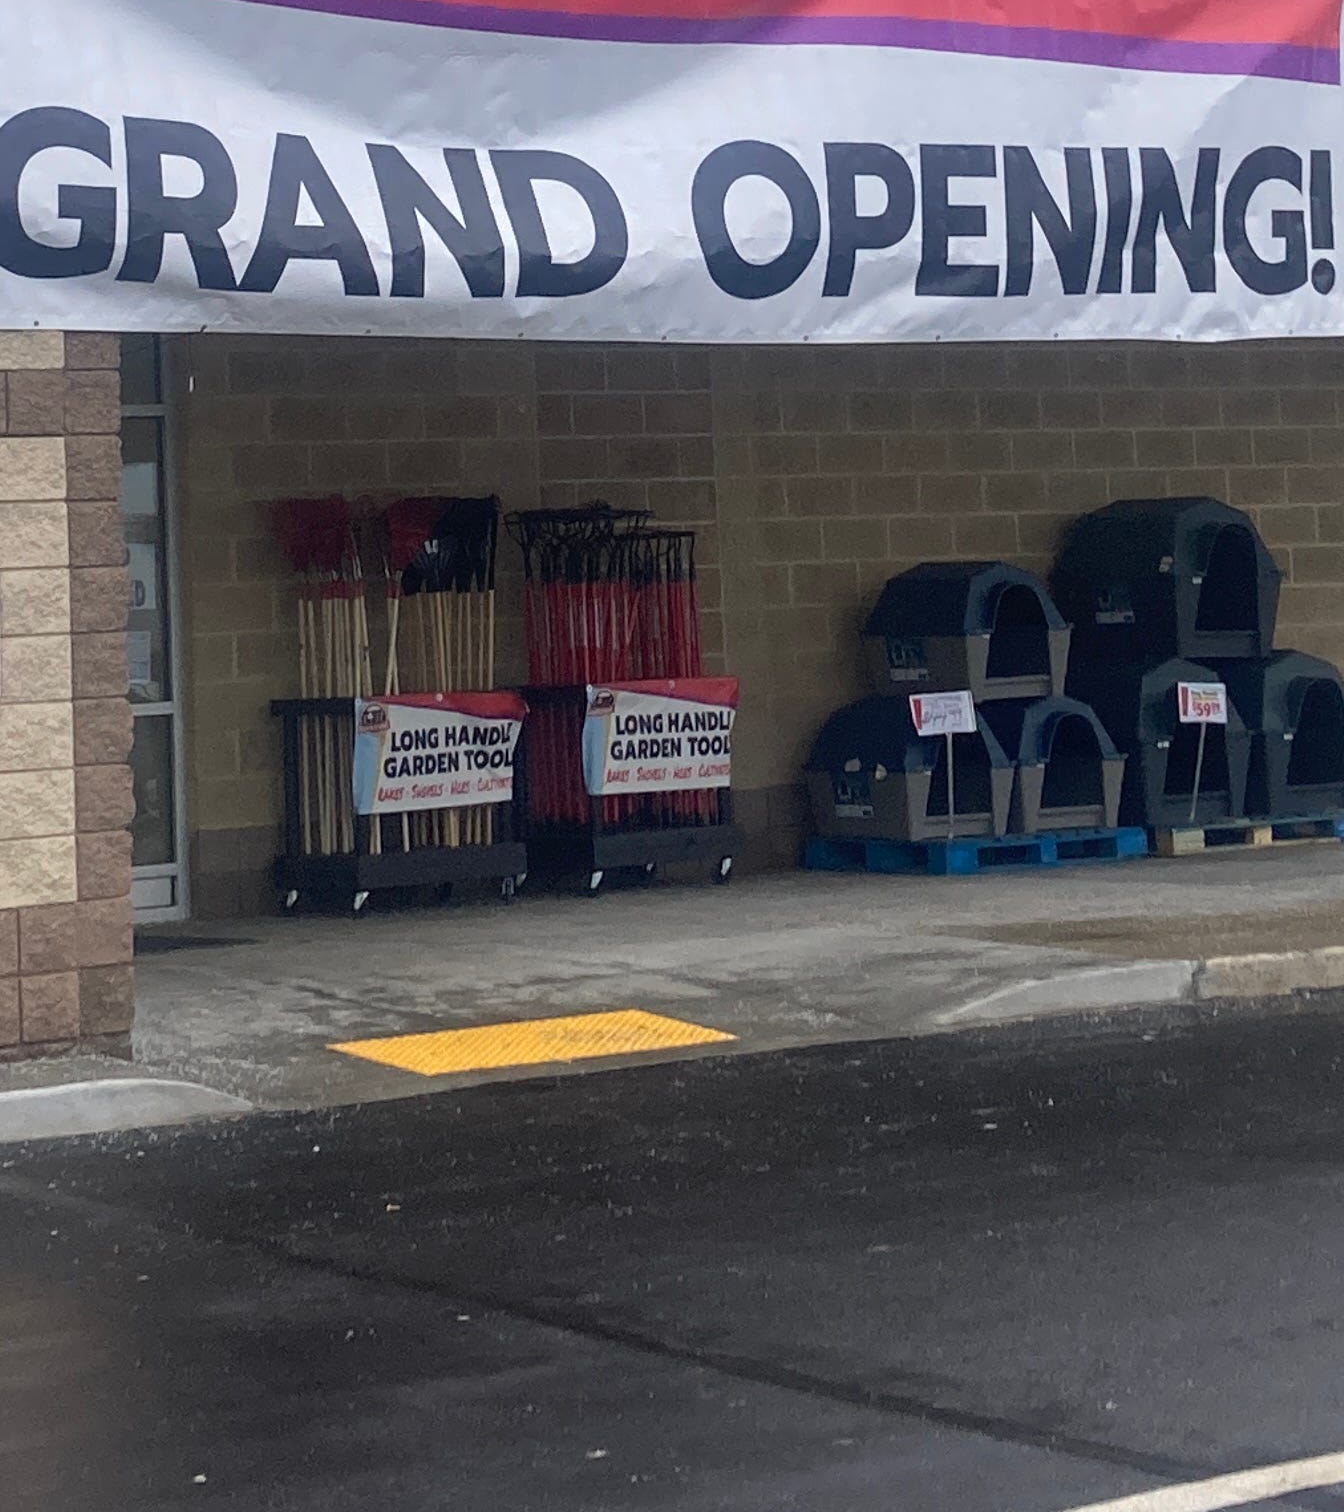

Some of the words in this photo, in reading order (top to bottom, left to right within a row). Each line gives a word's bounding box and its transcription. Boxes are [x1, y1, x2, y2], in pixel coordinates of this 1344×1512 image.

[690, 138, 1336, 300] OPENING!
[616, 713, 663, 736] LONG
[391, 726, 439, 753] LONG
[610, 737, 682, 761] GARDEN
[383, 751, 460, 779] GARDEN
